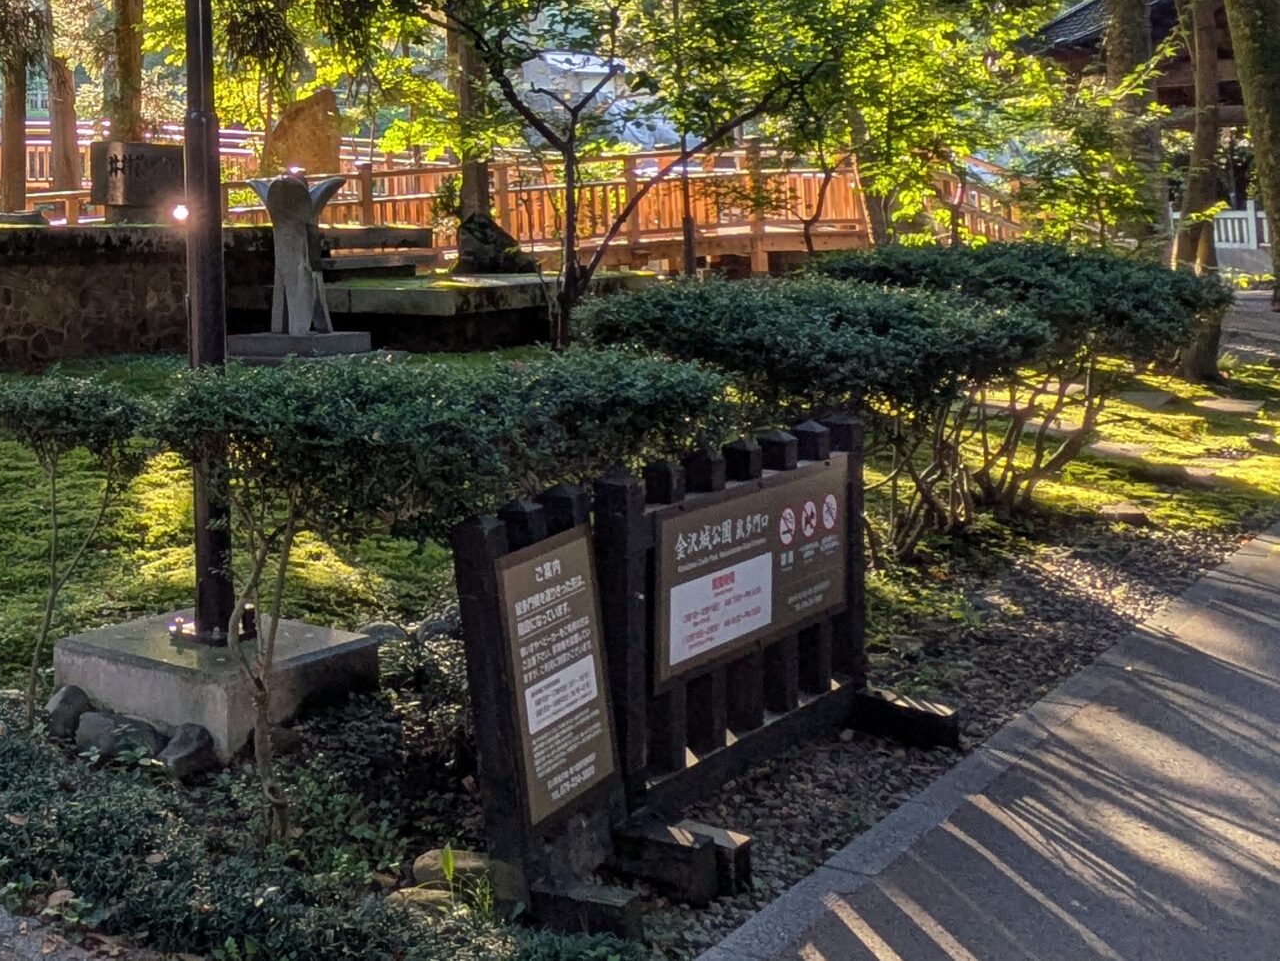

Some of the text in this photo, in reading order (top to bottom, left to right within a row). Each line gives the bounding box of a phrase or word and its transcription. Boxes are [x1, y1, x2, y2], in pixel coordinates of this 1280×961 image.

[675, 519, 732, 560] 金沢城公園
[535, 559, 561, 582] ご案内
